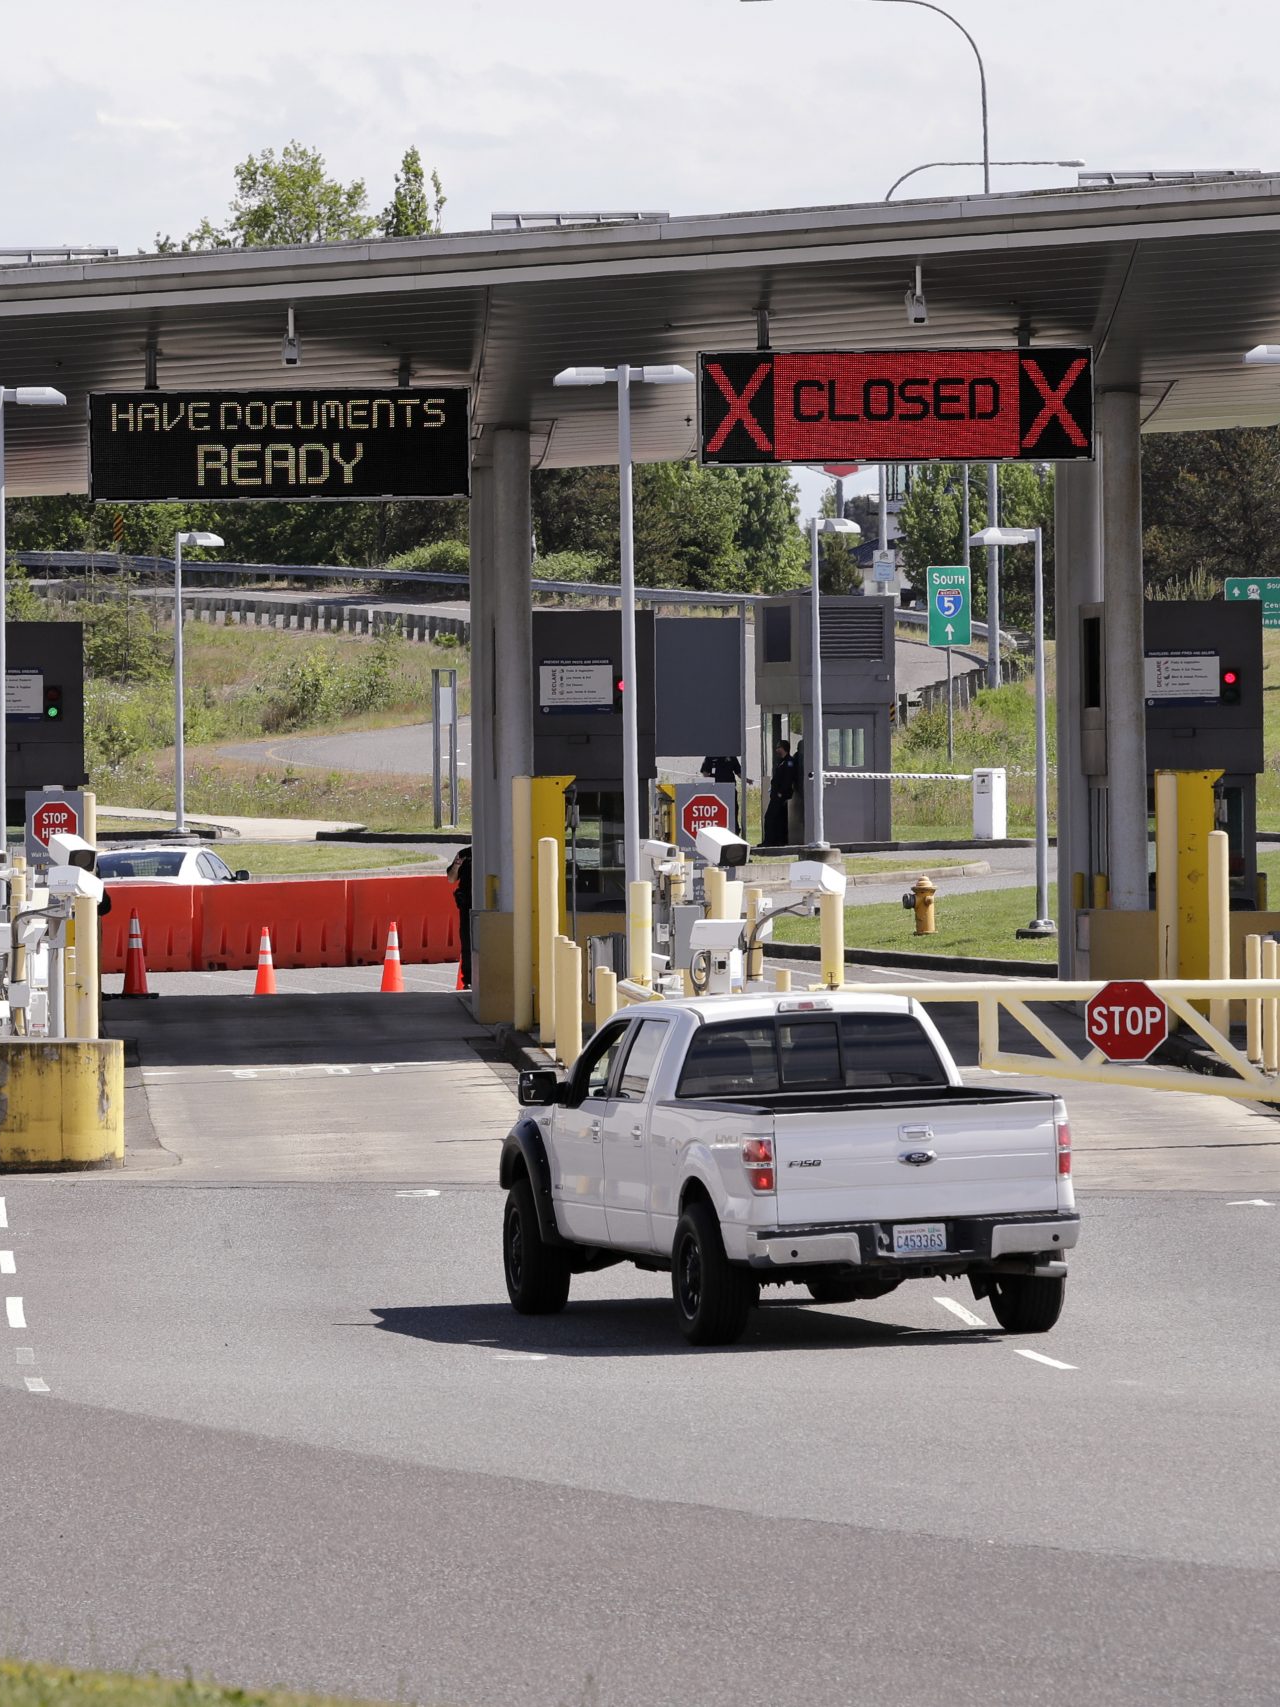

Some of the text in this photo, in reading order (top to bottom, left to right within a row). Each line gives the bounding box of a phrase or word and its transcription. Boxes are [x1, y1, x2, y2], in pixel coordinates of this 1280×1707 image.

[793, 377, 1000, 422] CLOSED
[111, 398, 445, 431] HAVE DOCUMENTS
[197, 442, 364, 486] READY
[932, 572, 966, 585] SOUTH
[943, 597, 955, 616] 5
[42, 812, 68, 824] STOP
[692, 806, 718, 817] STOP
[1091, 1006, 1162, 1036] STOP
[896, 1234, 943, 1248] C45336S
